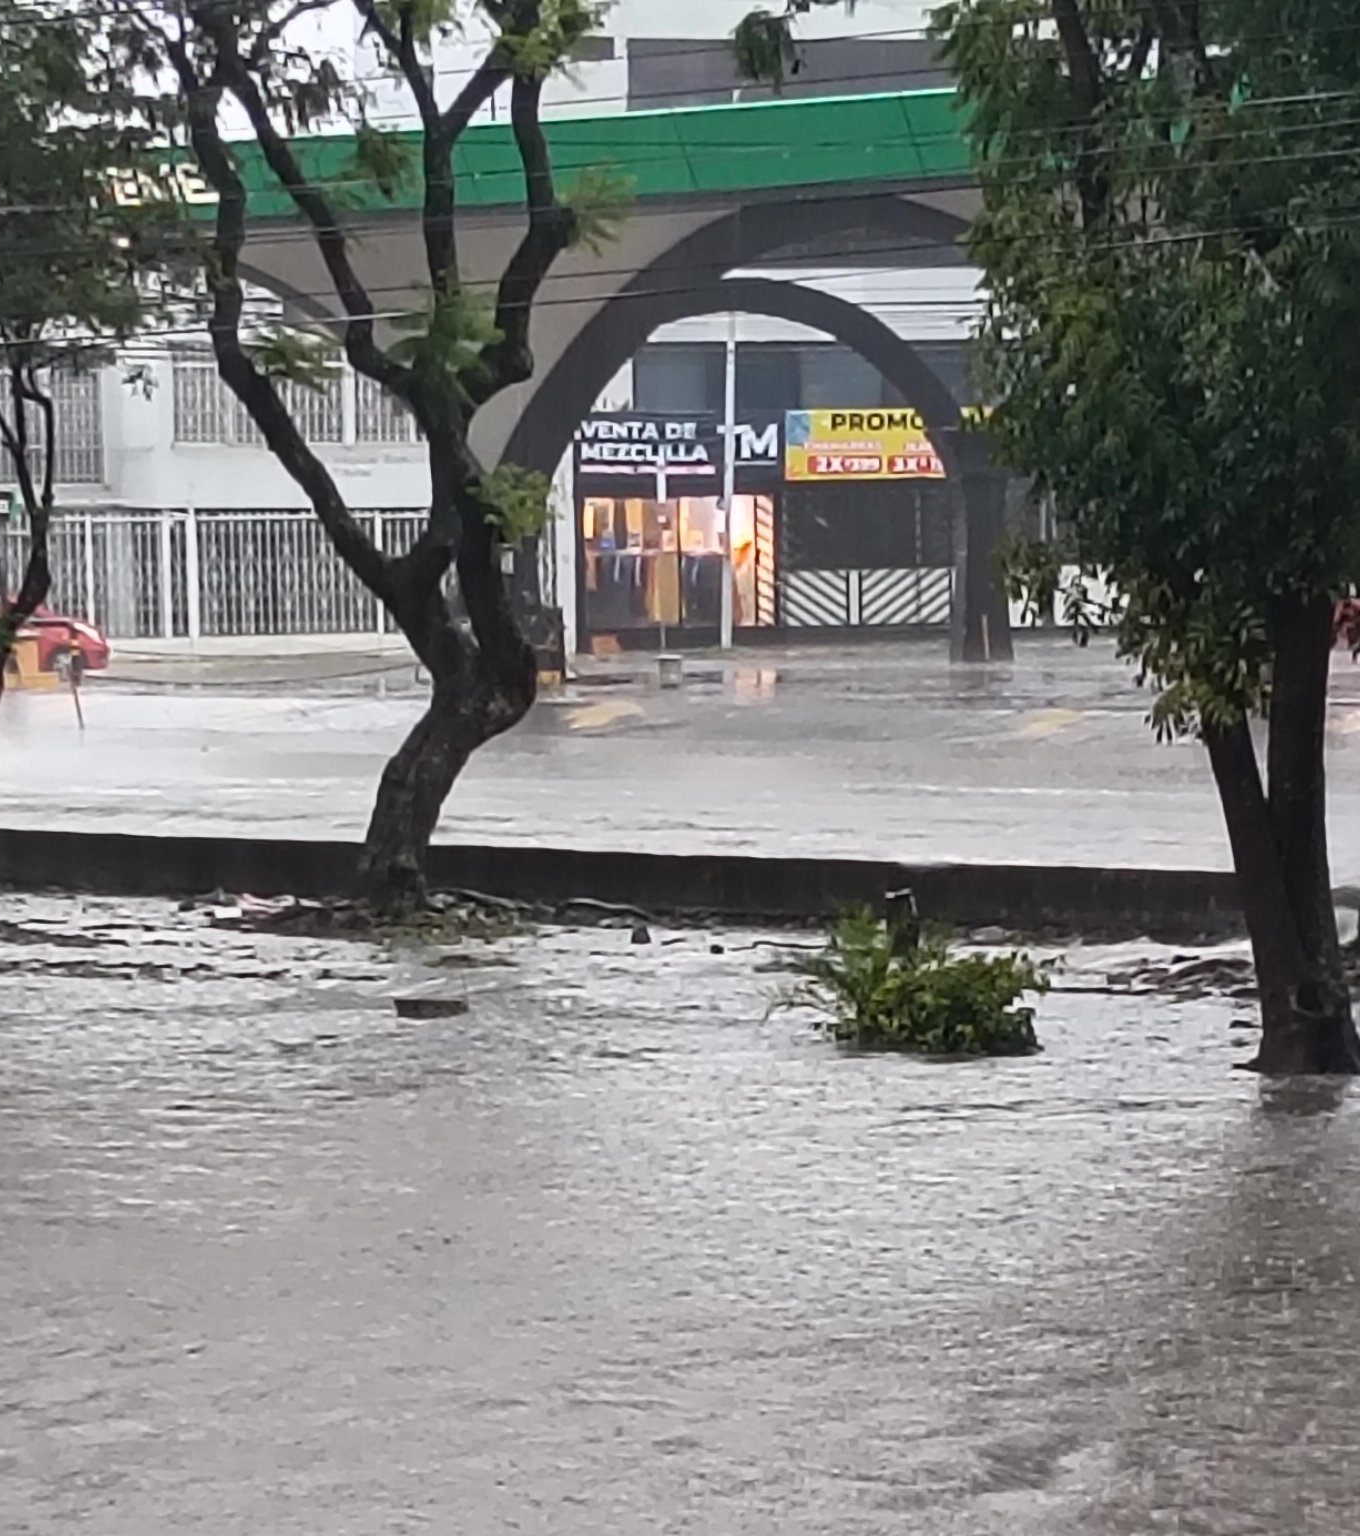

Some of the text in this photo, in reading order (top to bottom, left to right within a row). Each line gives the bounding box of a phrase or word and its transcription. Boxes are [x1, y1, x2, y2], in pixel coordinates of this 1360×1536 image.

[581, 421, 697, 439] VENTA DE
[716, 424, 778, 459] TM
[581, 442, 710, 461] MEZCLLLA
